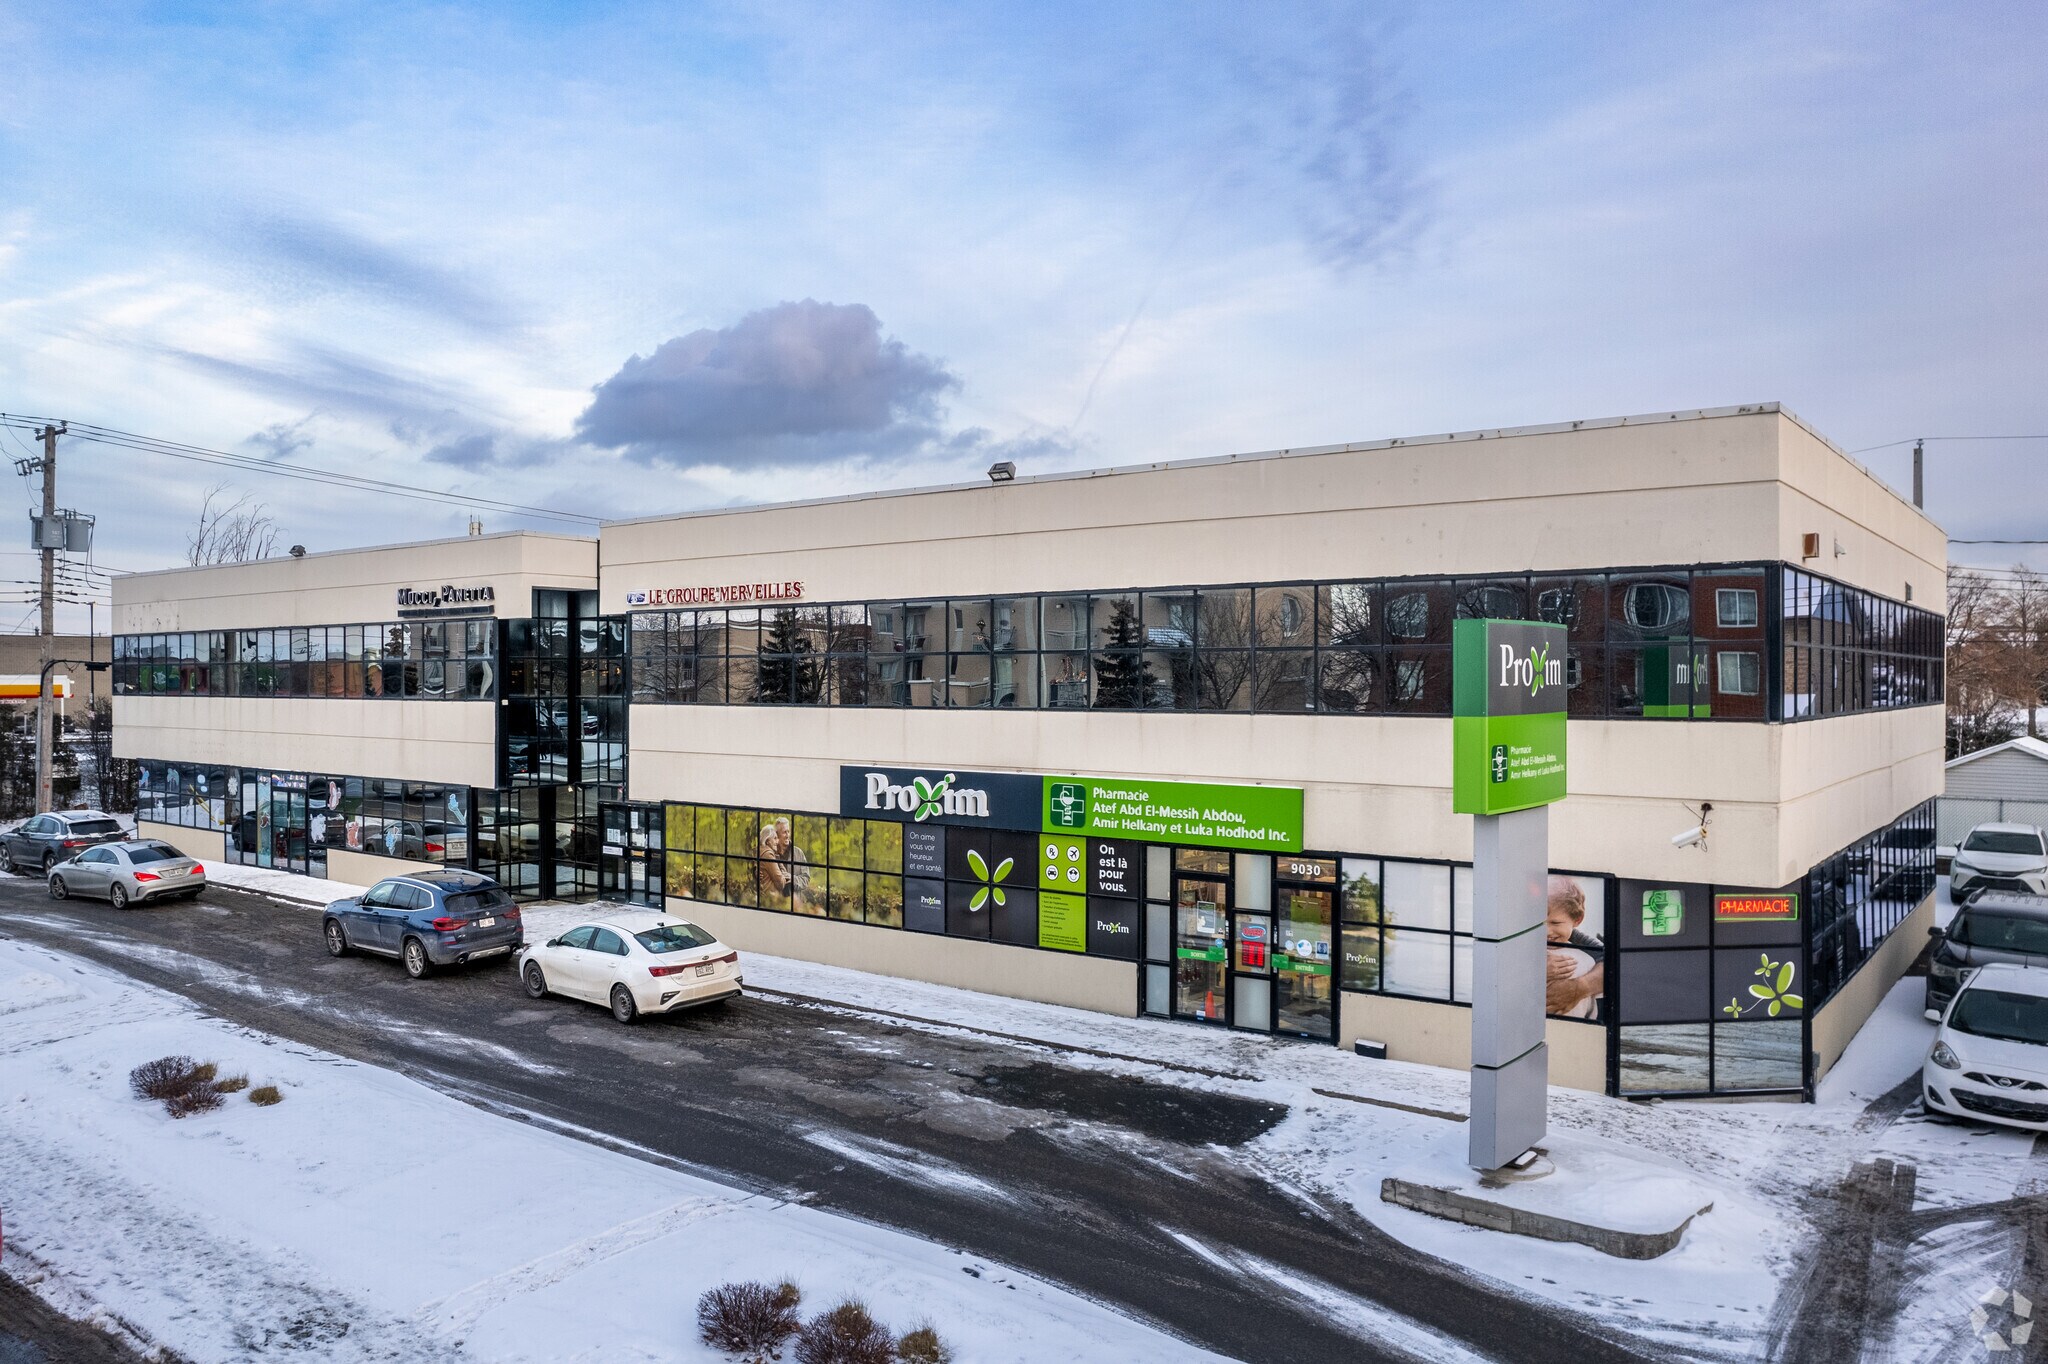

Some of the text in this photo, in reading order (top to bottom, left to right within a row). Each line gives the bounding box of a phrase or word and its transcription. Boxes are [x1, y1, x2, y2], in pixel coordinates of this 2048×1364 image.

[649, 589, 663, 604] LE
[666, 587, 716, 604] GROUPE
[719, 581, 802, 601] MERVEILLES
[1092, 787, 1149, 802] Pharmacie
[1092, 802, 1246, 825] Atef Abd El-Messih Abdou,
[1092, 816, 1291, 843] Amir Helkany et Luka Hodhod Inc.
[909, 831, 936, 842] On aime
[909, 843, 936, 852] vous voir
[1099, 844, 1115, 855] On
[909, 852, 933, 861] heureux
[1099, 857, 1128, 869] est là
[1099, 868, 1124, 880] pour
[1291, 863, 1321, 876] 9030
[1099, 881, 1127, 893] vous.
[1719, 899, 1790, 914] PHARMACIE
